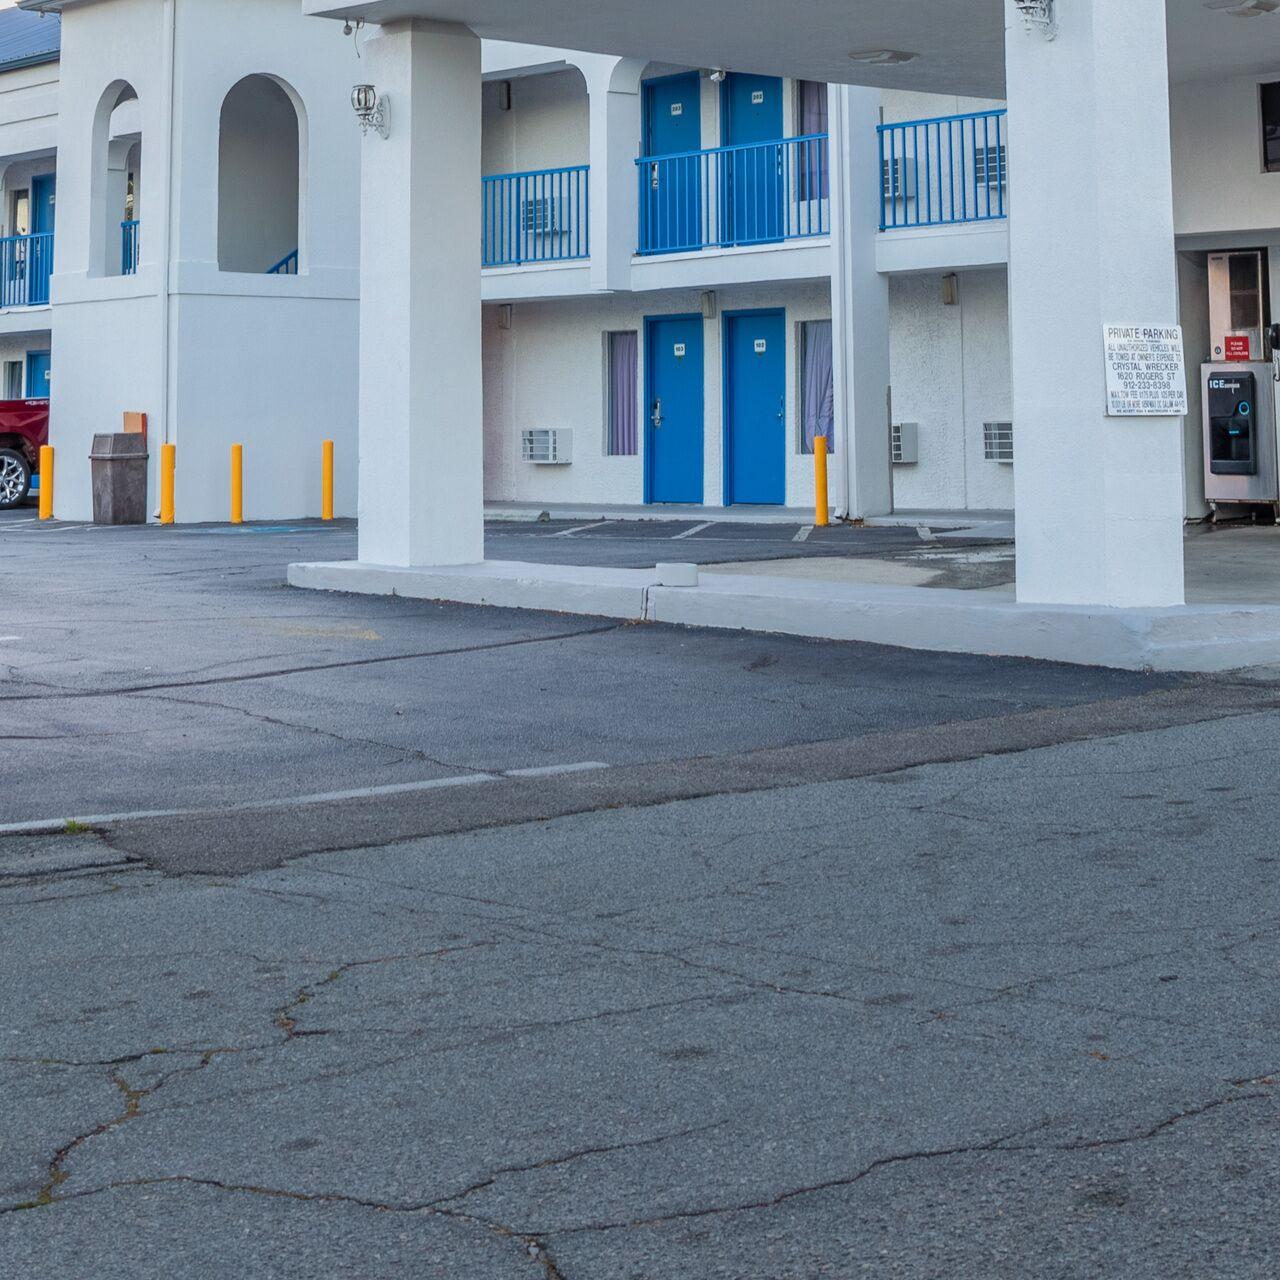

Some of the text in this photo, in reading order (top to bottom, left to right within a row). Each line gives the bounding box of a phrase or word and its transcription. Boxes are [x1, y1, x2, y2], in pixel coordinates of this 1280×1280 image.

[1108, 327, 1178, 339] PRIVATE PARKING
[1112, 362, 1179, 371] CRYSTAL WRECKER
[1117, 372, 1175, 381] 1620 ROGERS ST
[1210, 380, 1224, 388] ICE
